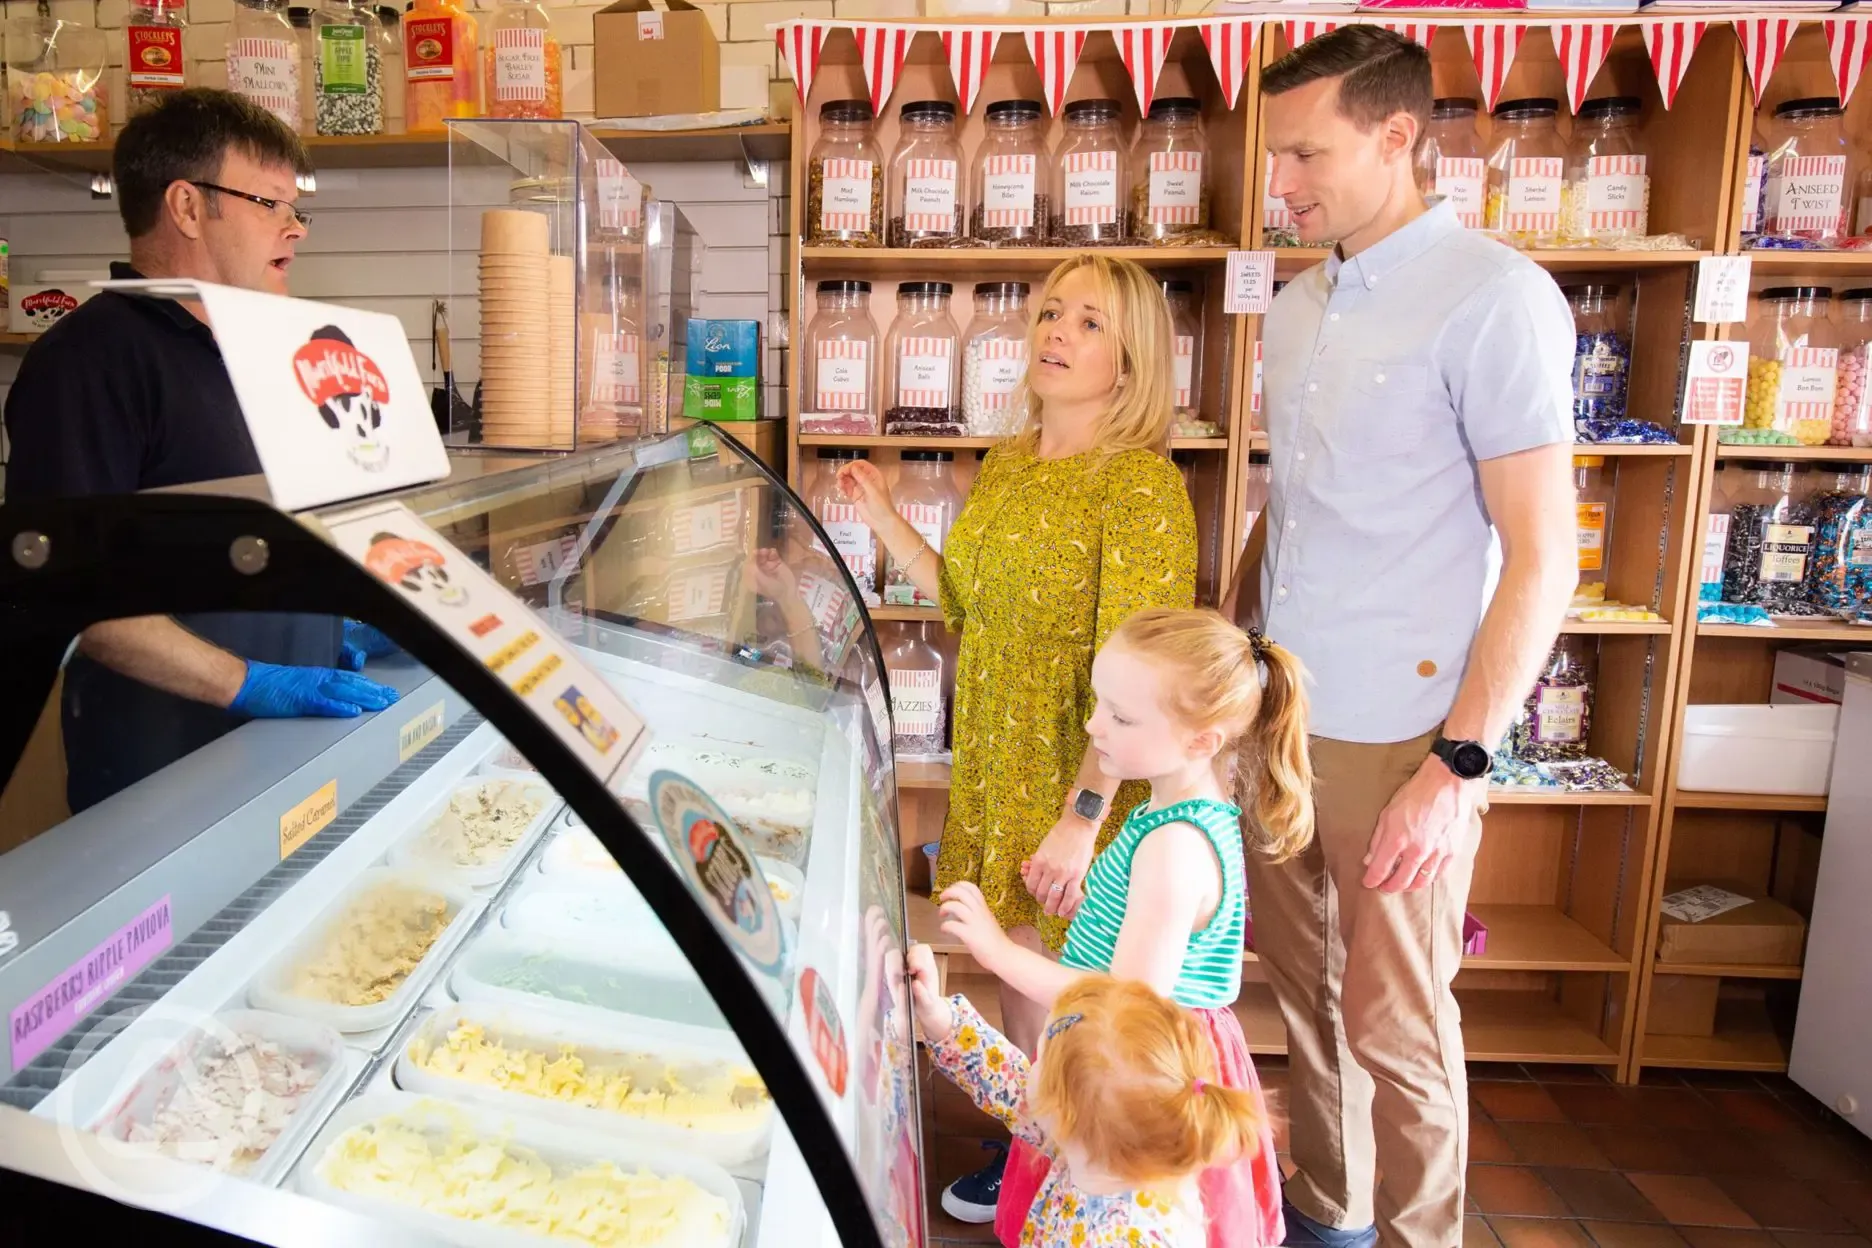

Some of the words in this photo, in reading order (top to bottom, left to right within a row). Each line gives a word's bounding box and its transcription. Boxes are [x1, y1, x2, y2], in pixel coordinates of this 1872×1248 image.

[1606, 184, 1627, 192] Candy
[1785, 182, 1839, 195] ANISEED
[1790, 197, 1832, 210] TWIST
[704, 337, 731, 352] Lion
[1764, 543, 1807, 553] LIQUORICE
[1772, 554, 1801, 564] Toffees
[282, 813, 306, 845] Salted
[306, 791, 336, 826] Caramel
[14, 971, 84, 1043] RASPBERRY
[87, 938, 124, 986] RIPPLE
[126, 903, 170, 954] PAVLOVA
